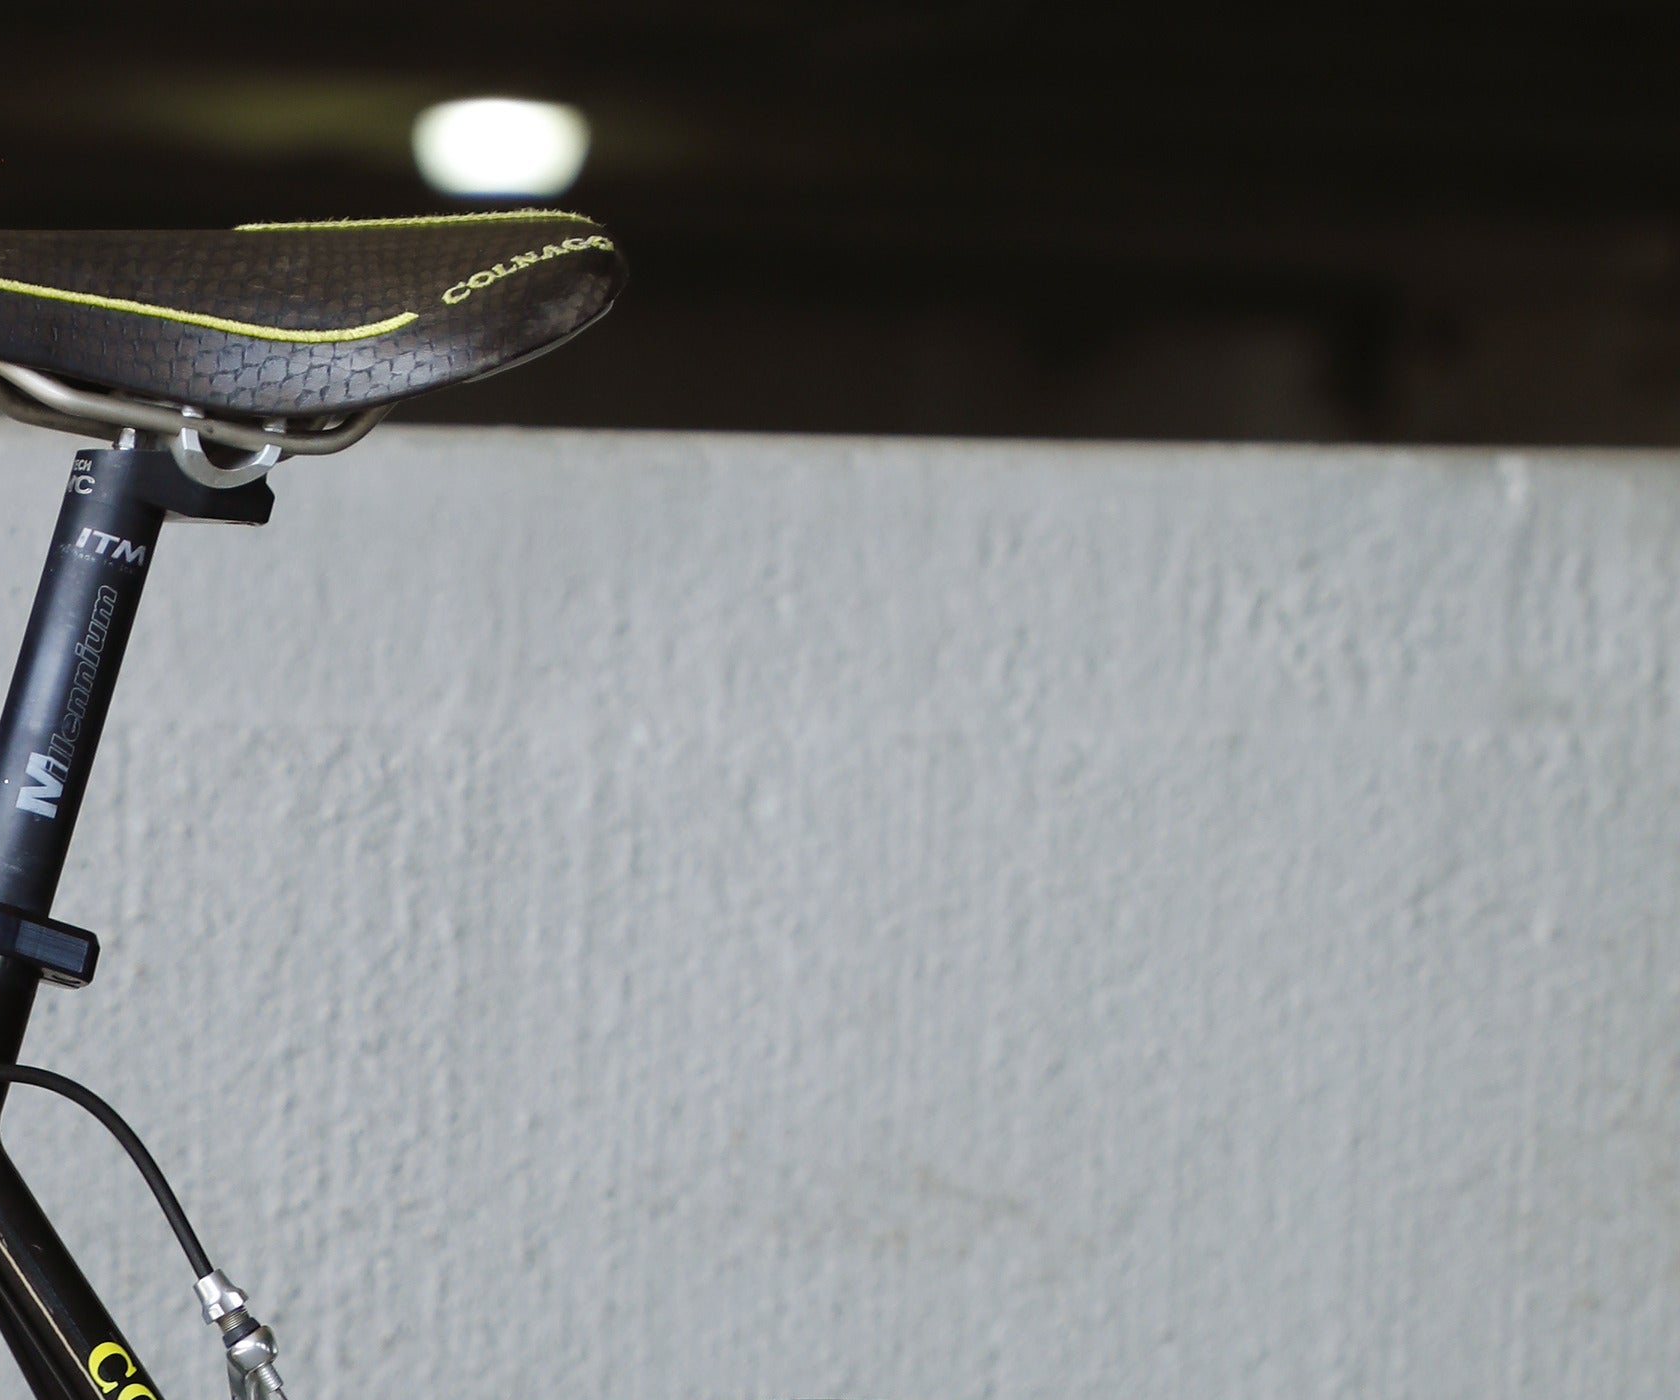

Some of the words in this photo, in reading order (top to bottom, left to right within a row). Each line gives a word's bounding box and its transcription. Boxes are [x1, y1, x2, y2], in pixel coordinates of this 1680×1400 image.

[441, 235, 614, 305] COLNAGO
[75, 527, 146, 566] ITM
[16, 584, 118, 819] Millennium
